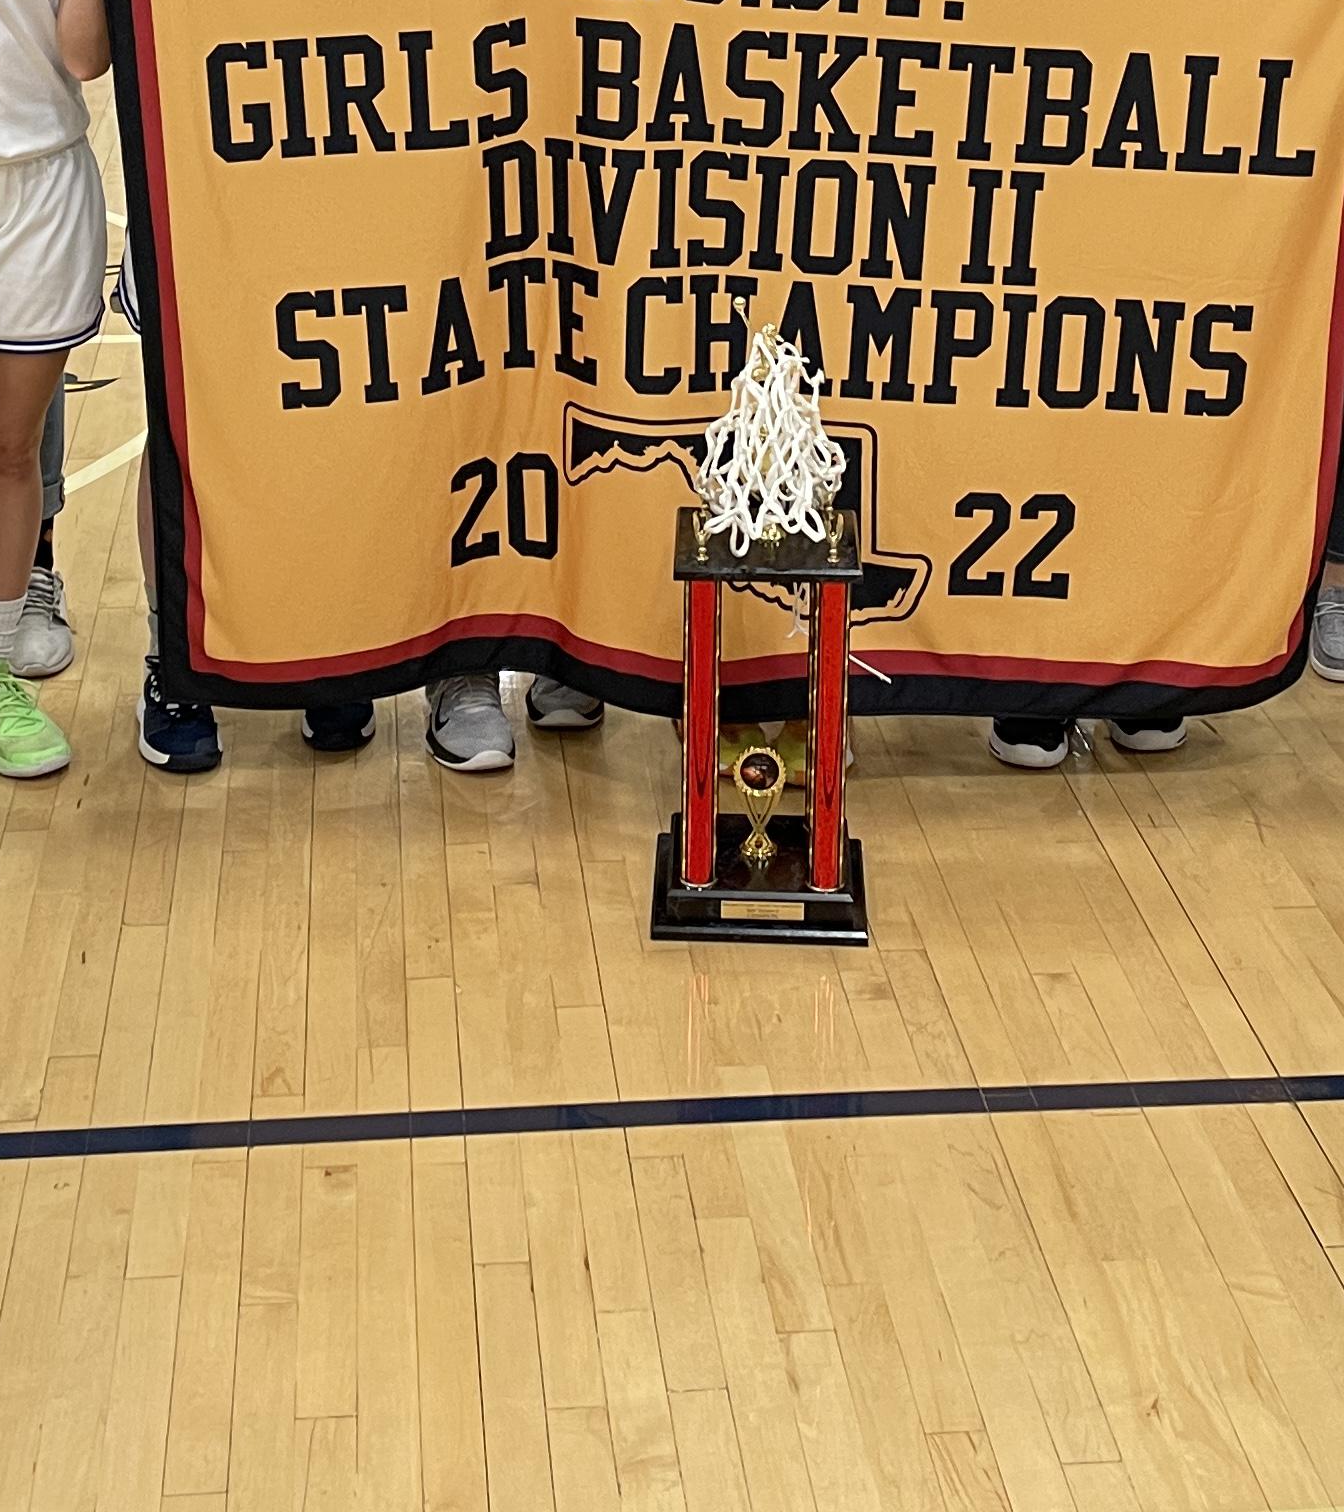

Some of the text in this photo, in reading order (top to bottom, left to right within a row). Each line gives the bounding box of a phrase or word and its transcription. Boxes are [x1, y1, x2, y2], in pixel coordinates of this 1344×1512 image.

[204, 16, 1317, 179] GIRLS BASKETBALL
[481, 138, 1046, 288] DIVISION II
[273, 257, 1255, 418] STATE CHAMPIONS
[449, 451, 1077, 603] 20 22
